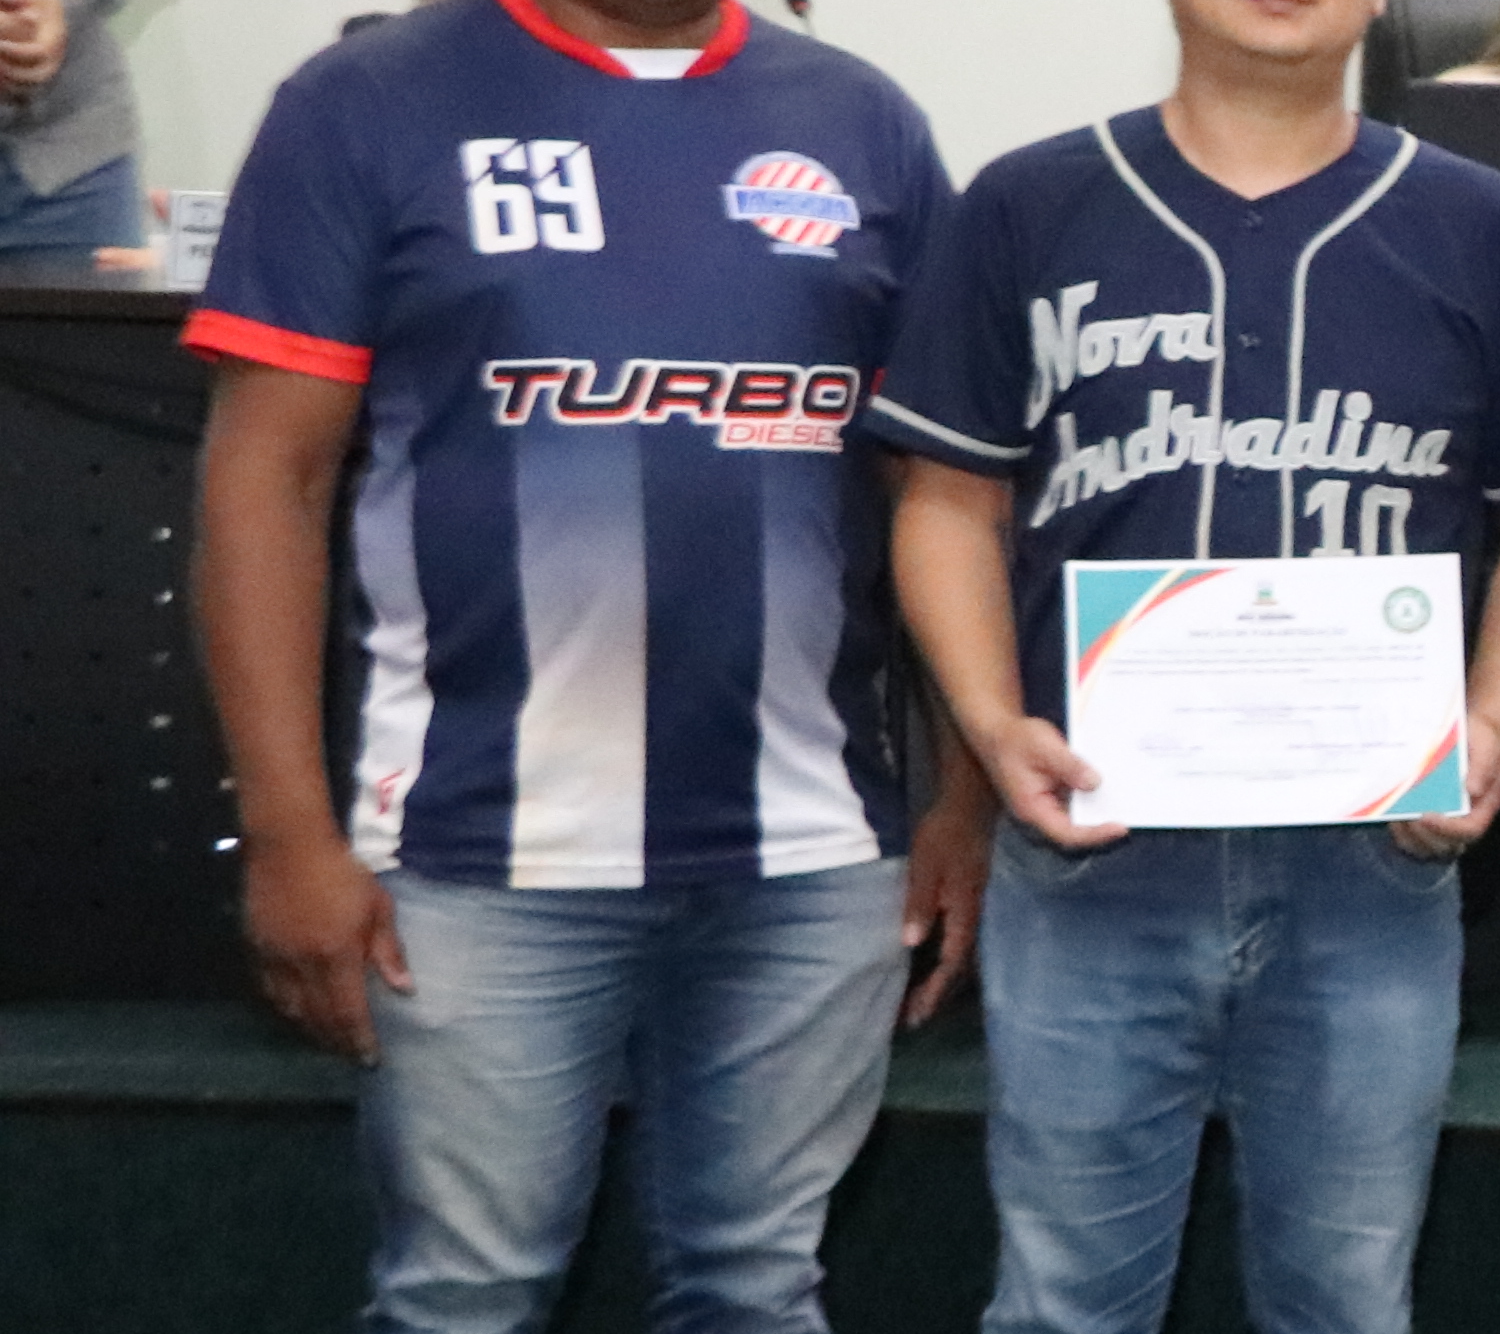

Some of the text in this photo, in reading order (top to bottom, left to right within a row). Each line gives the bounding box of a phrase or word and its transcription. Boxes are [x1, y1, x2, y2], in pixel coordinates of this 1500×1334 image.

[459, 138, 605, 255] 69
[485, 358, 860, 425] TURBO
[1024, 281, 1220, 429] Nova
[1030, 389, 1452, 527] Andradina
[1304, 479, 1413, 556] 10
